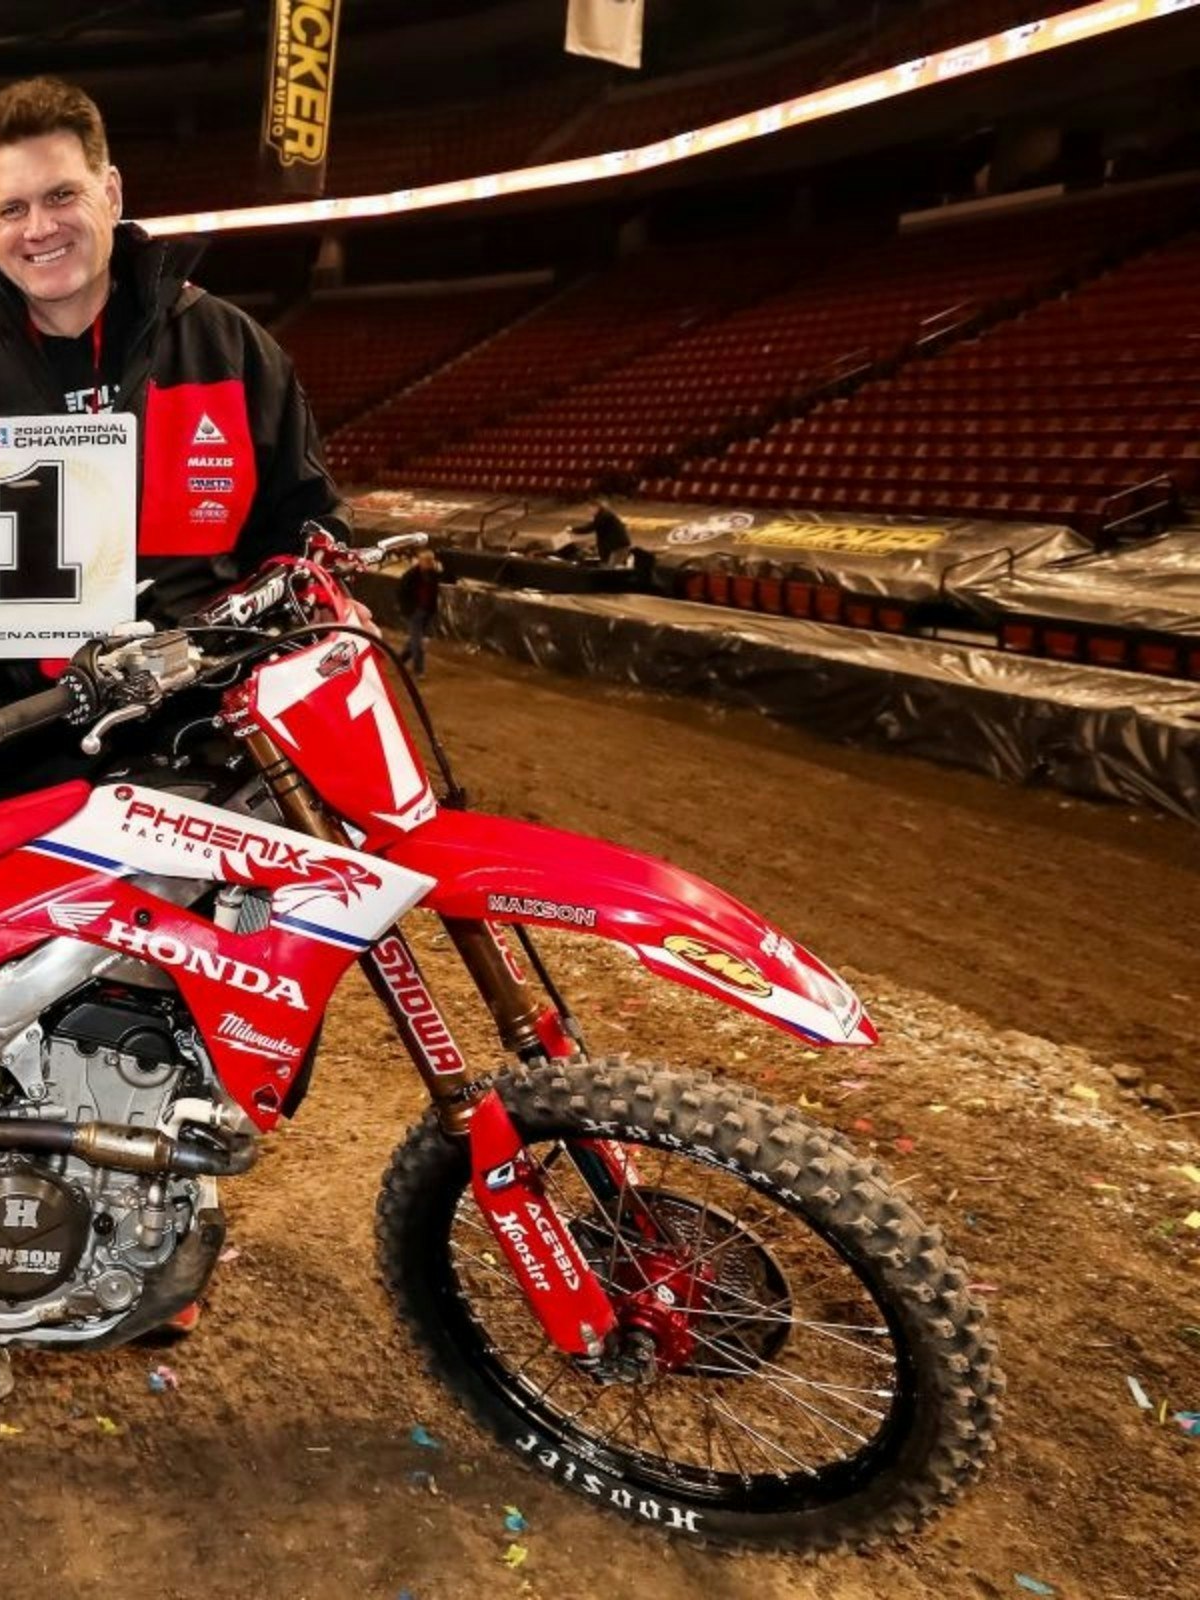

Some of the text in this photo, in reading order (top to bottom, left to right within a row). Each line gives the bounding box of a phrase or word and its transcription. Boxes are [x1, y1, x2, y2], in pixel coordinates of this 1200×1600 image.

[271, 77, 288, 137] AUDIO
[13, 433, 127, 448] CHAMPION
[54, 422, 127, 436] NATIONAL
[187, 457, 233, 468] MAXXIS
[121, 824, 213, 860] RACING
[125, 799, 311, 871] PHOENIX
[488, 895, 597, 928] MAKSON
[102, 918, 311, 1011] HONDA
[370, 935, 466, 1075] SHOWA
[217, 1012, 302, 1057] Milwaukee
[3, 1199, 41, 1229] H
[491, 1210, 551, 1292] Hoosier
